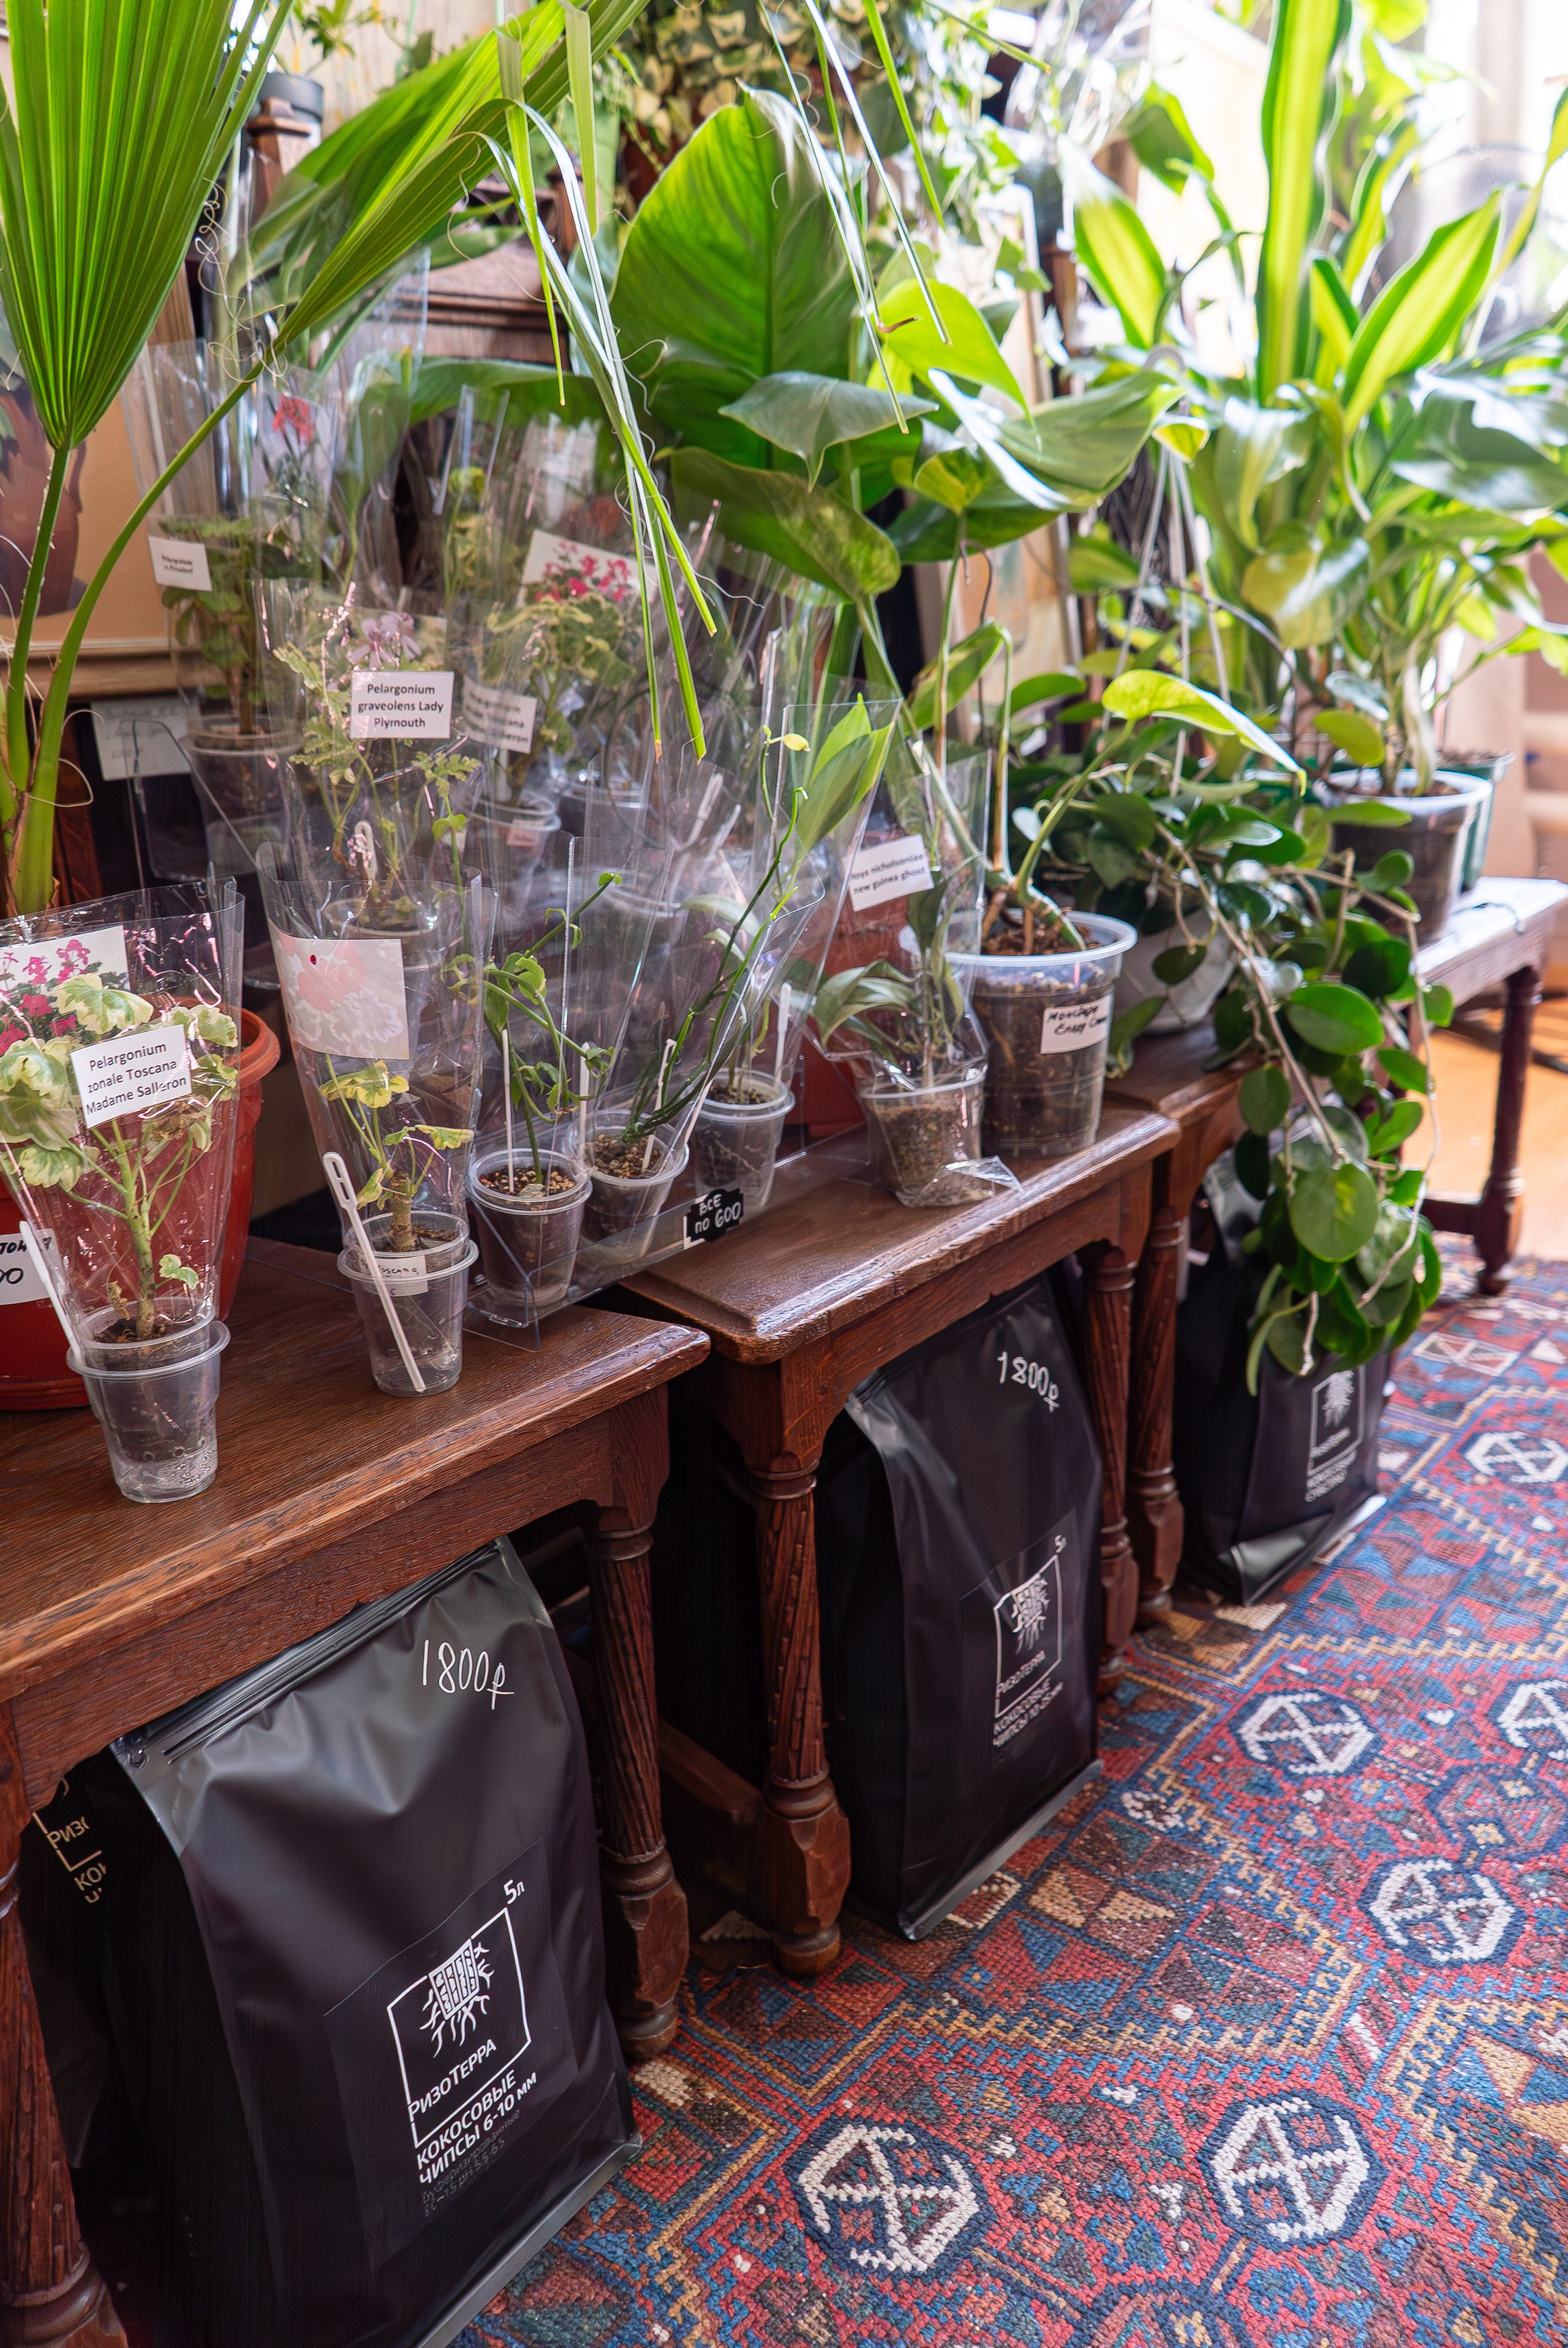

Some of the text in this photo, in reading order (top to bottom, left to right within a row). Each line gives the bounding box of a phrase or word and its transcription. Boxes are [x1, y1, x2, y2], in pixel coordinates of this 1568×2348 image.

[367, 684, 435, 696] Pelargonium
[358, 700, 444, 712] graveolens Lady
[374, 717, 426, 729] Plymouth
[853, 884, 871, 895] new
[89, 1043, 167, 1071] Pelargonium
[87, 1060, 177, 1094] zonale Toscana
[86, 1077, 187, 1115] Madame Salleron
[714, 1201, 742, 1228] 600
[417, 2069, 517, 2170] КОКОСОВЫЕ
[419, 2071, 538, 2184] ЧИПСЫ 6-10 мм
